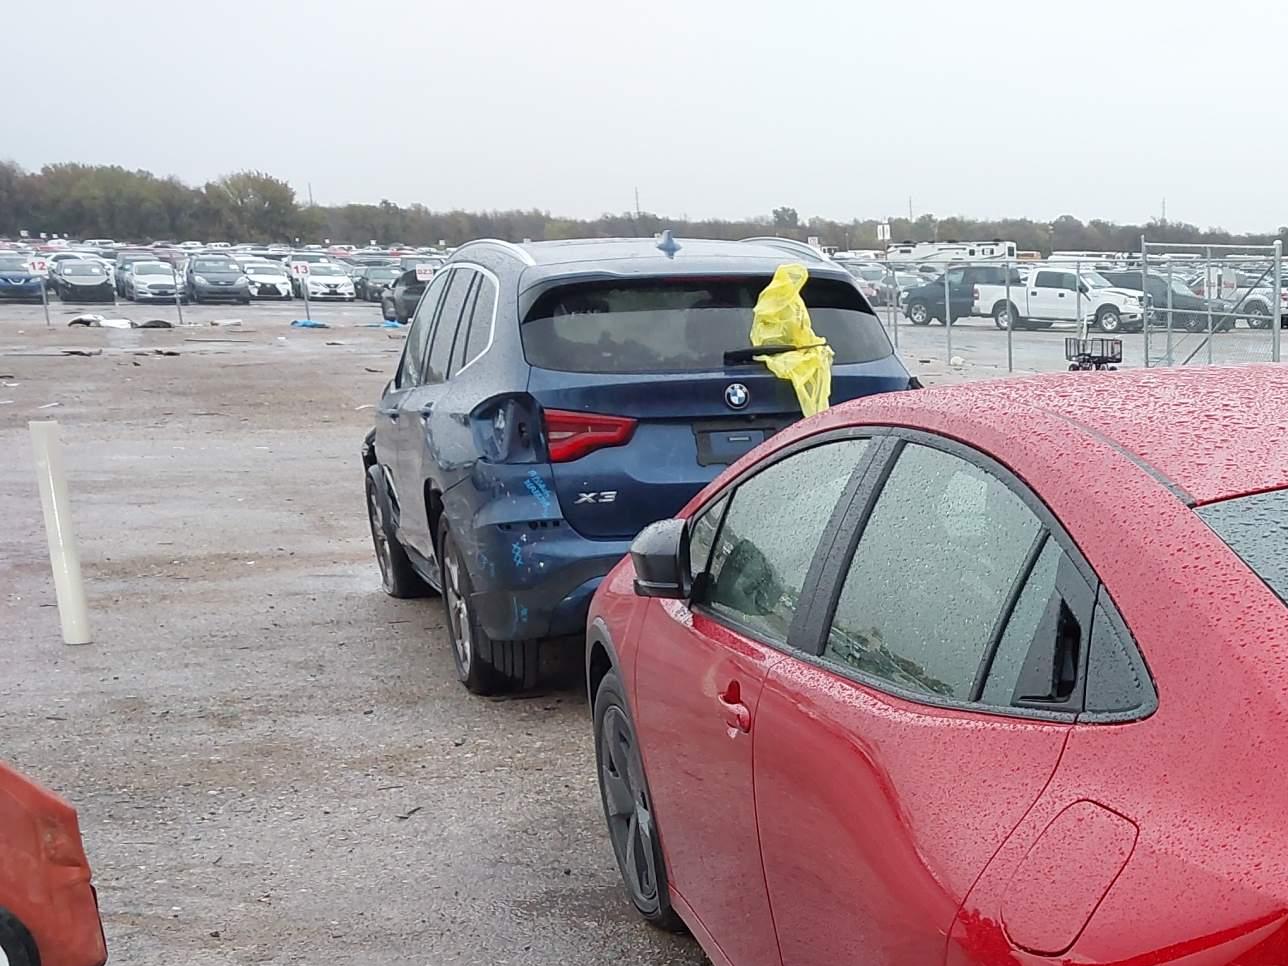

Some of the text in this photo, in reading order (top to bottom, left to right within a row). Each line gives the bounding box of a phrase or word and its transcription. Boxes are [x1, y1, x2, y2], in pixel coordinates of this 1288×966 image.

[30, 261, 46, 271] 12
[293, 264, 308, 274] 13
[574, 490, 617, 504] X3
